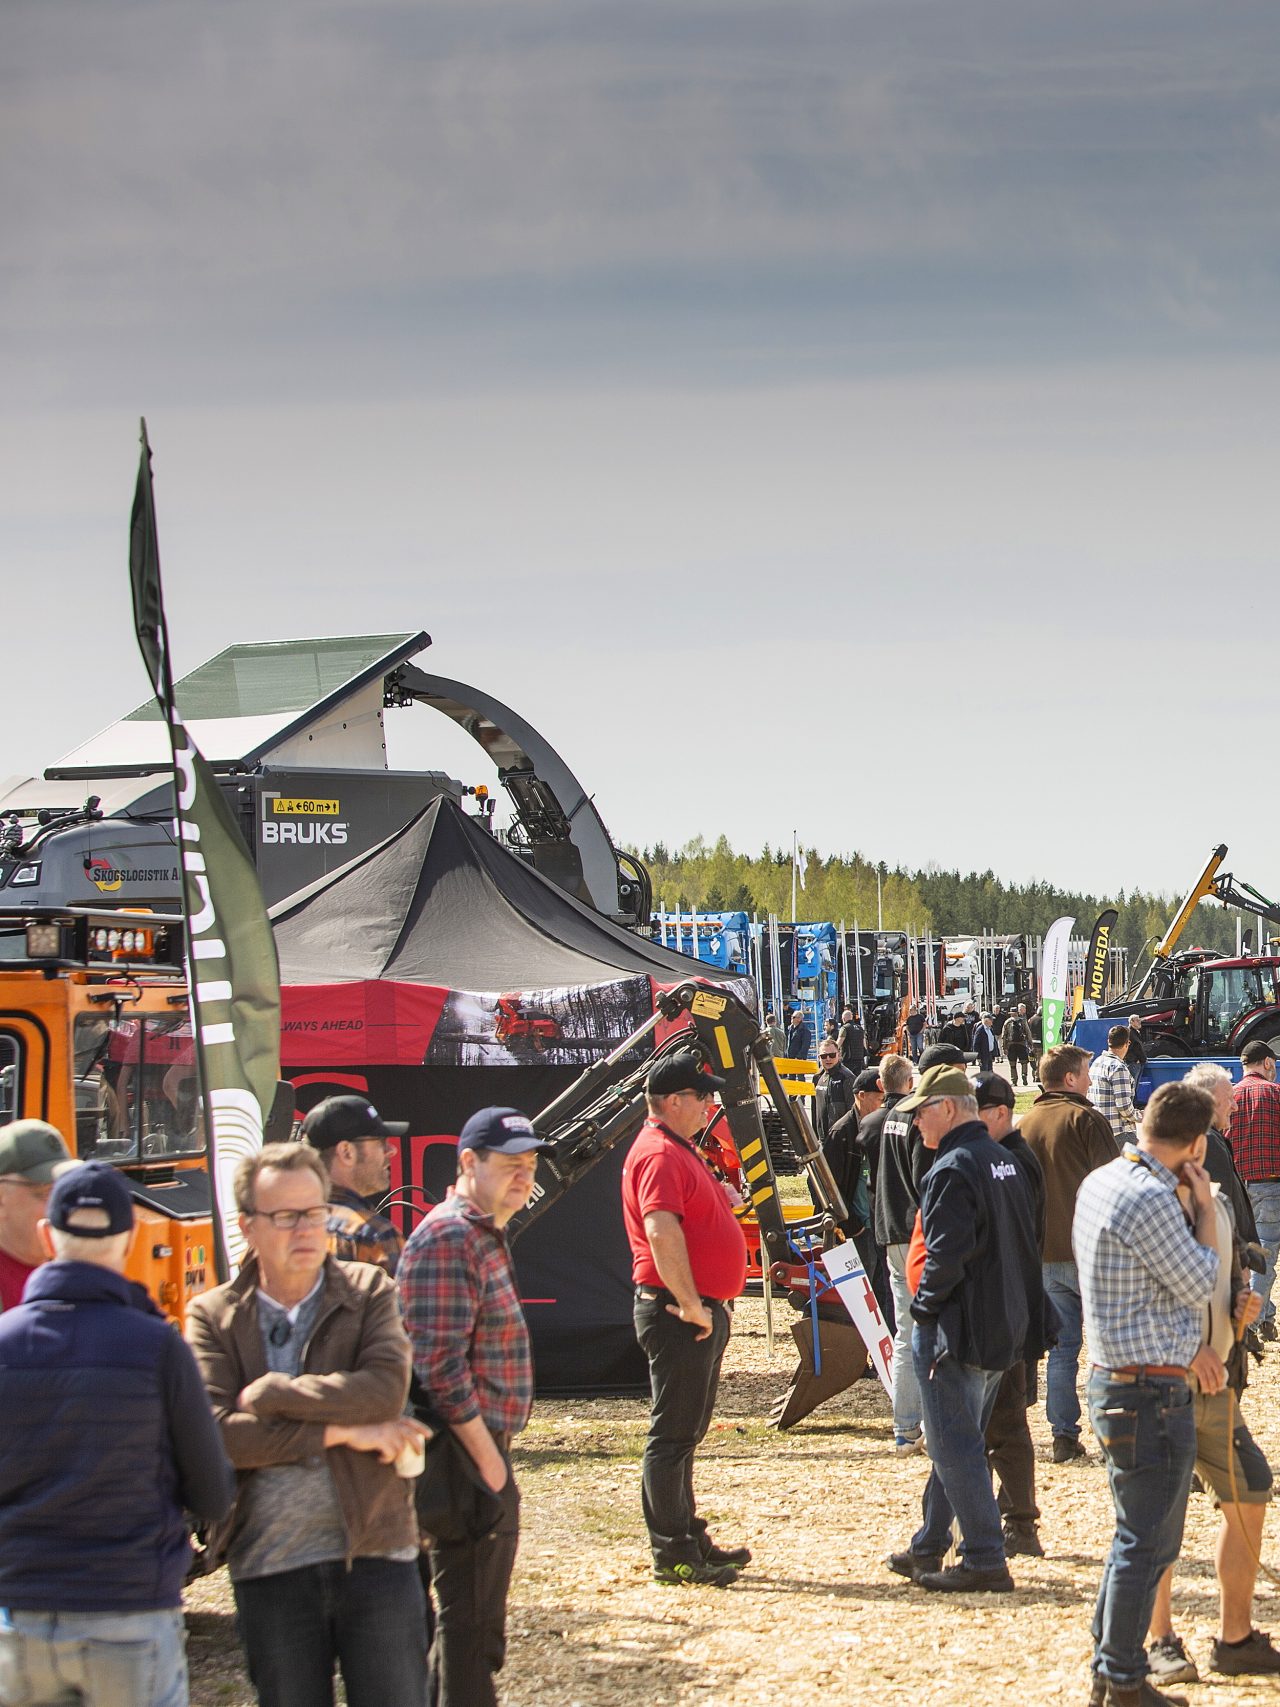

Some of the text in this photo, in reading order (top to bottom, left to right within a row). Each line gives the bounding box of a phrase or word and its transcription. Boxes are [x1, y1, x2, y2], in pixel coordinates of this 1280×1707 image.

[302, 801, 314, 812] 60
[262, 822, 348, 844] BRUKS
[93, 868, 169, 882] SKOGSLOGISTIK
[1090, 926, 1110, 999] MOHEDA
[321, 1020, 364, 1031] AHEAD
